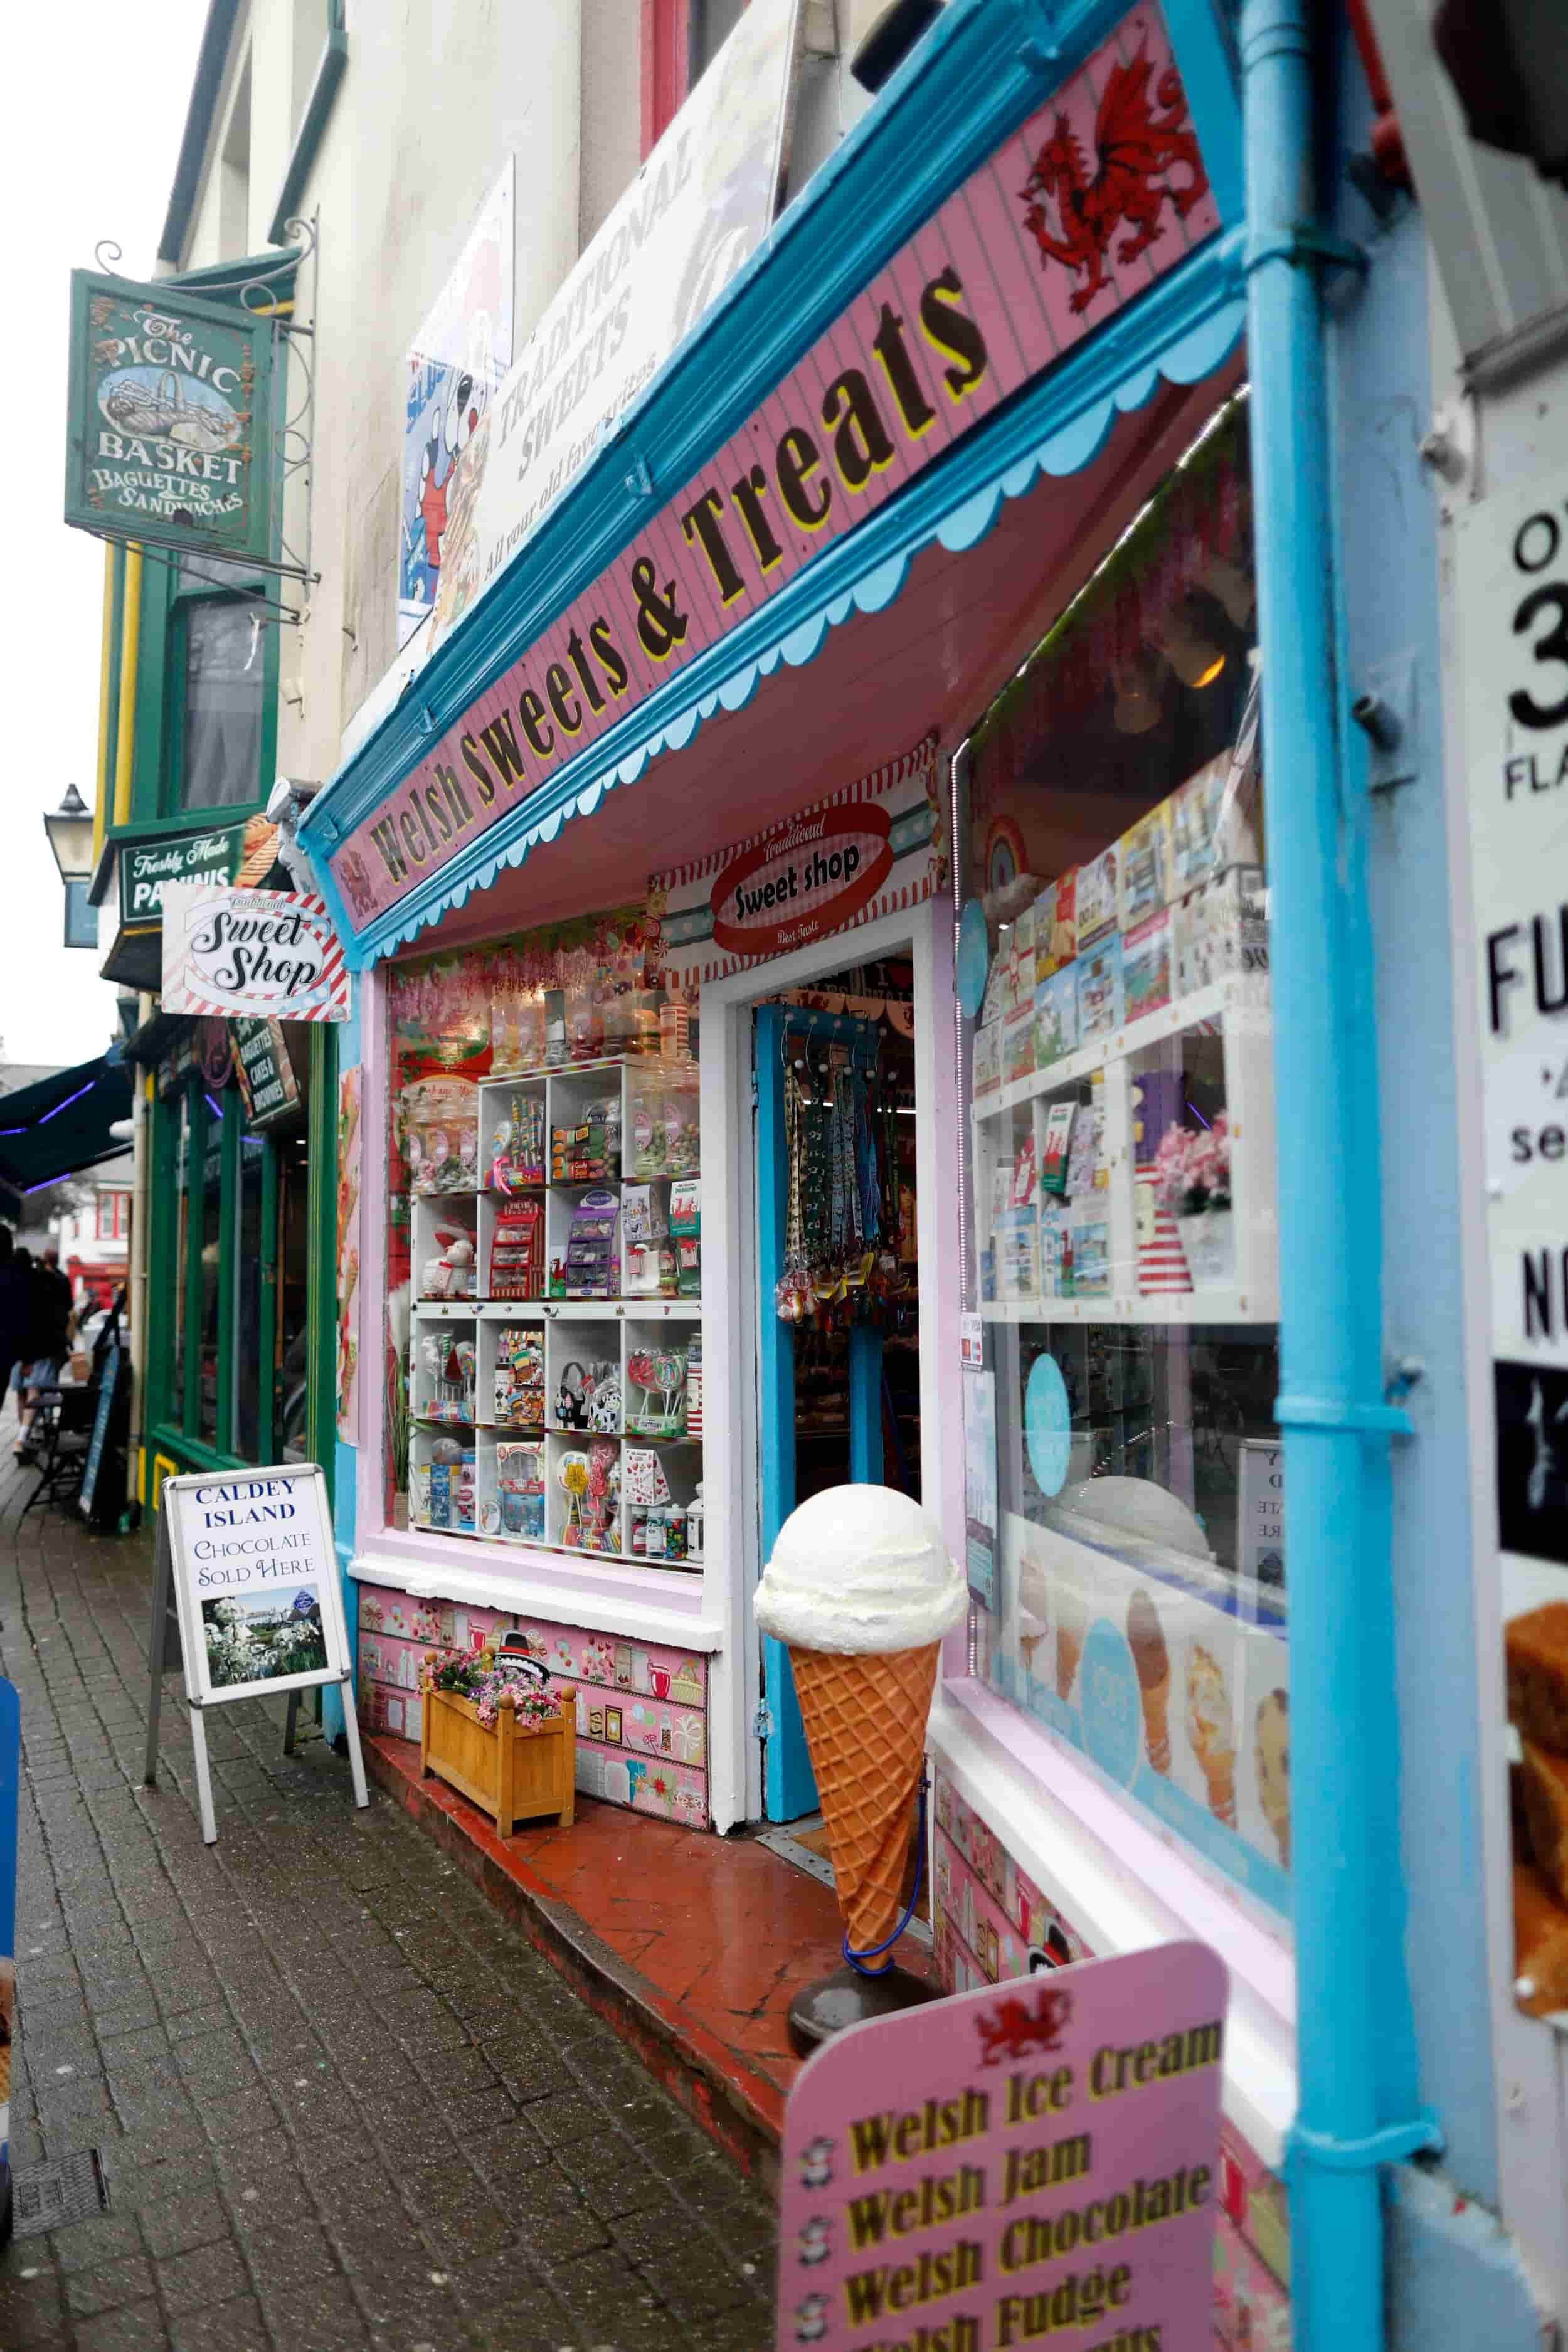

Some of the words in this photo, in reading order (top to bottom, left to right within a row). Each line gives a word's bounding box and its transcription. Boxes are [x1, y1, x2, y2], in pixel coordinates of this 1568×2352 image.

[132, 310, 194, 345] The
[105, 337, 242, 393] PICNIC
[518, 283, 632, 482] SWEETS
[98, 432, 243, 484] BASKET
[541, 457, 563, 509] old
[92, 469, 211, 501] BAGUETTES
[118, 487, 243, 516] SANDWICHES
[370, 763, 475, 886] Welsh
[460, 615, 628, 809] Sweets
[631, 556, 689, 662] &
[681, 265, 987, 608] Treats
[132, 850, 184, 878] Freshly
[186, 836, 230, 866] Made
[763, 813, 827, 863] Traditional
[735, 866, 798, 921] Sweet
[191, 912, 311, 953] Sweet
[778, 930, 795, 944] Best
[798, 921, 820, 939] Taste
[215, 946, 322, 996] Shop
[196, 1479, 296, 1505] CALDEY
[204, 1503, 295, 1528] ISLAND
[194, 1533, 312, 1560] CHOCOLATE
[198, 1567, 251, 1587] SOLD
[256, 1558, 315, 1579] HERE
[848, 2087, 991, 2178] Welsh
[1004, 2063, 1074, 2126] Ice
[1089, 2020, 1223, 2101] Cream
[845, 2162, 987, 2255] Welsh
[999, 2132, 1093, 2208] Jam
[843, 2238, 983, 2329] Welsh
[999, 2162, 1212, 2275] Chocolate
[995, 2262, 1133, 2349] Fudge
